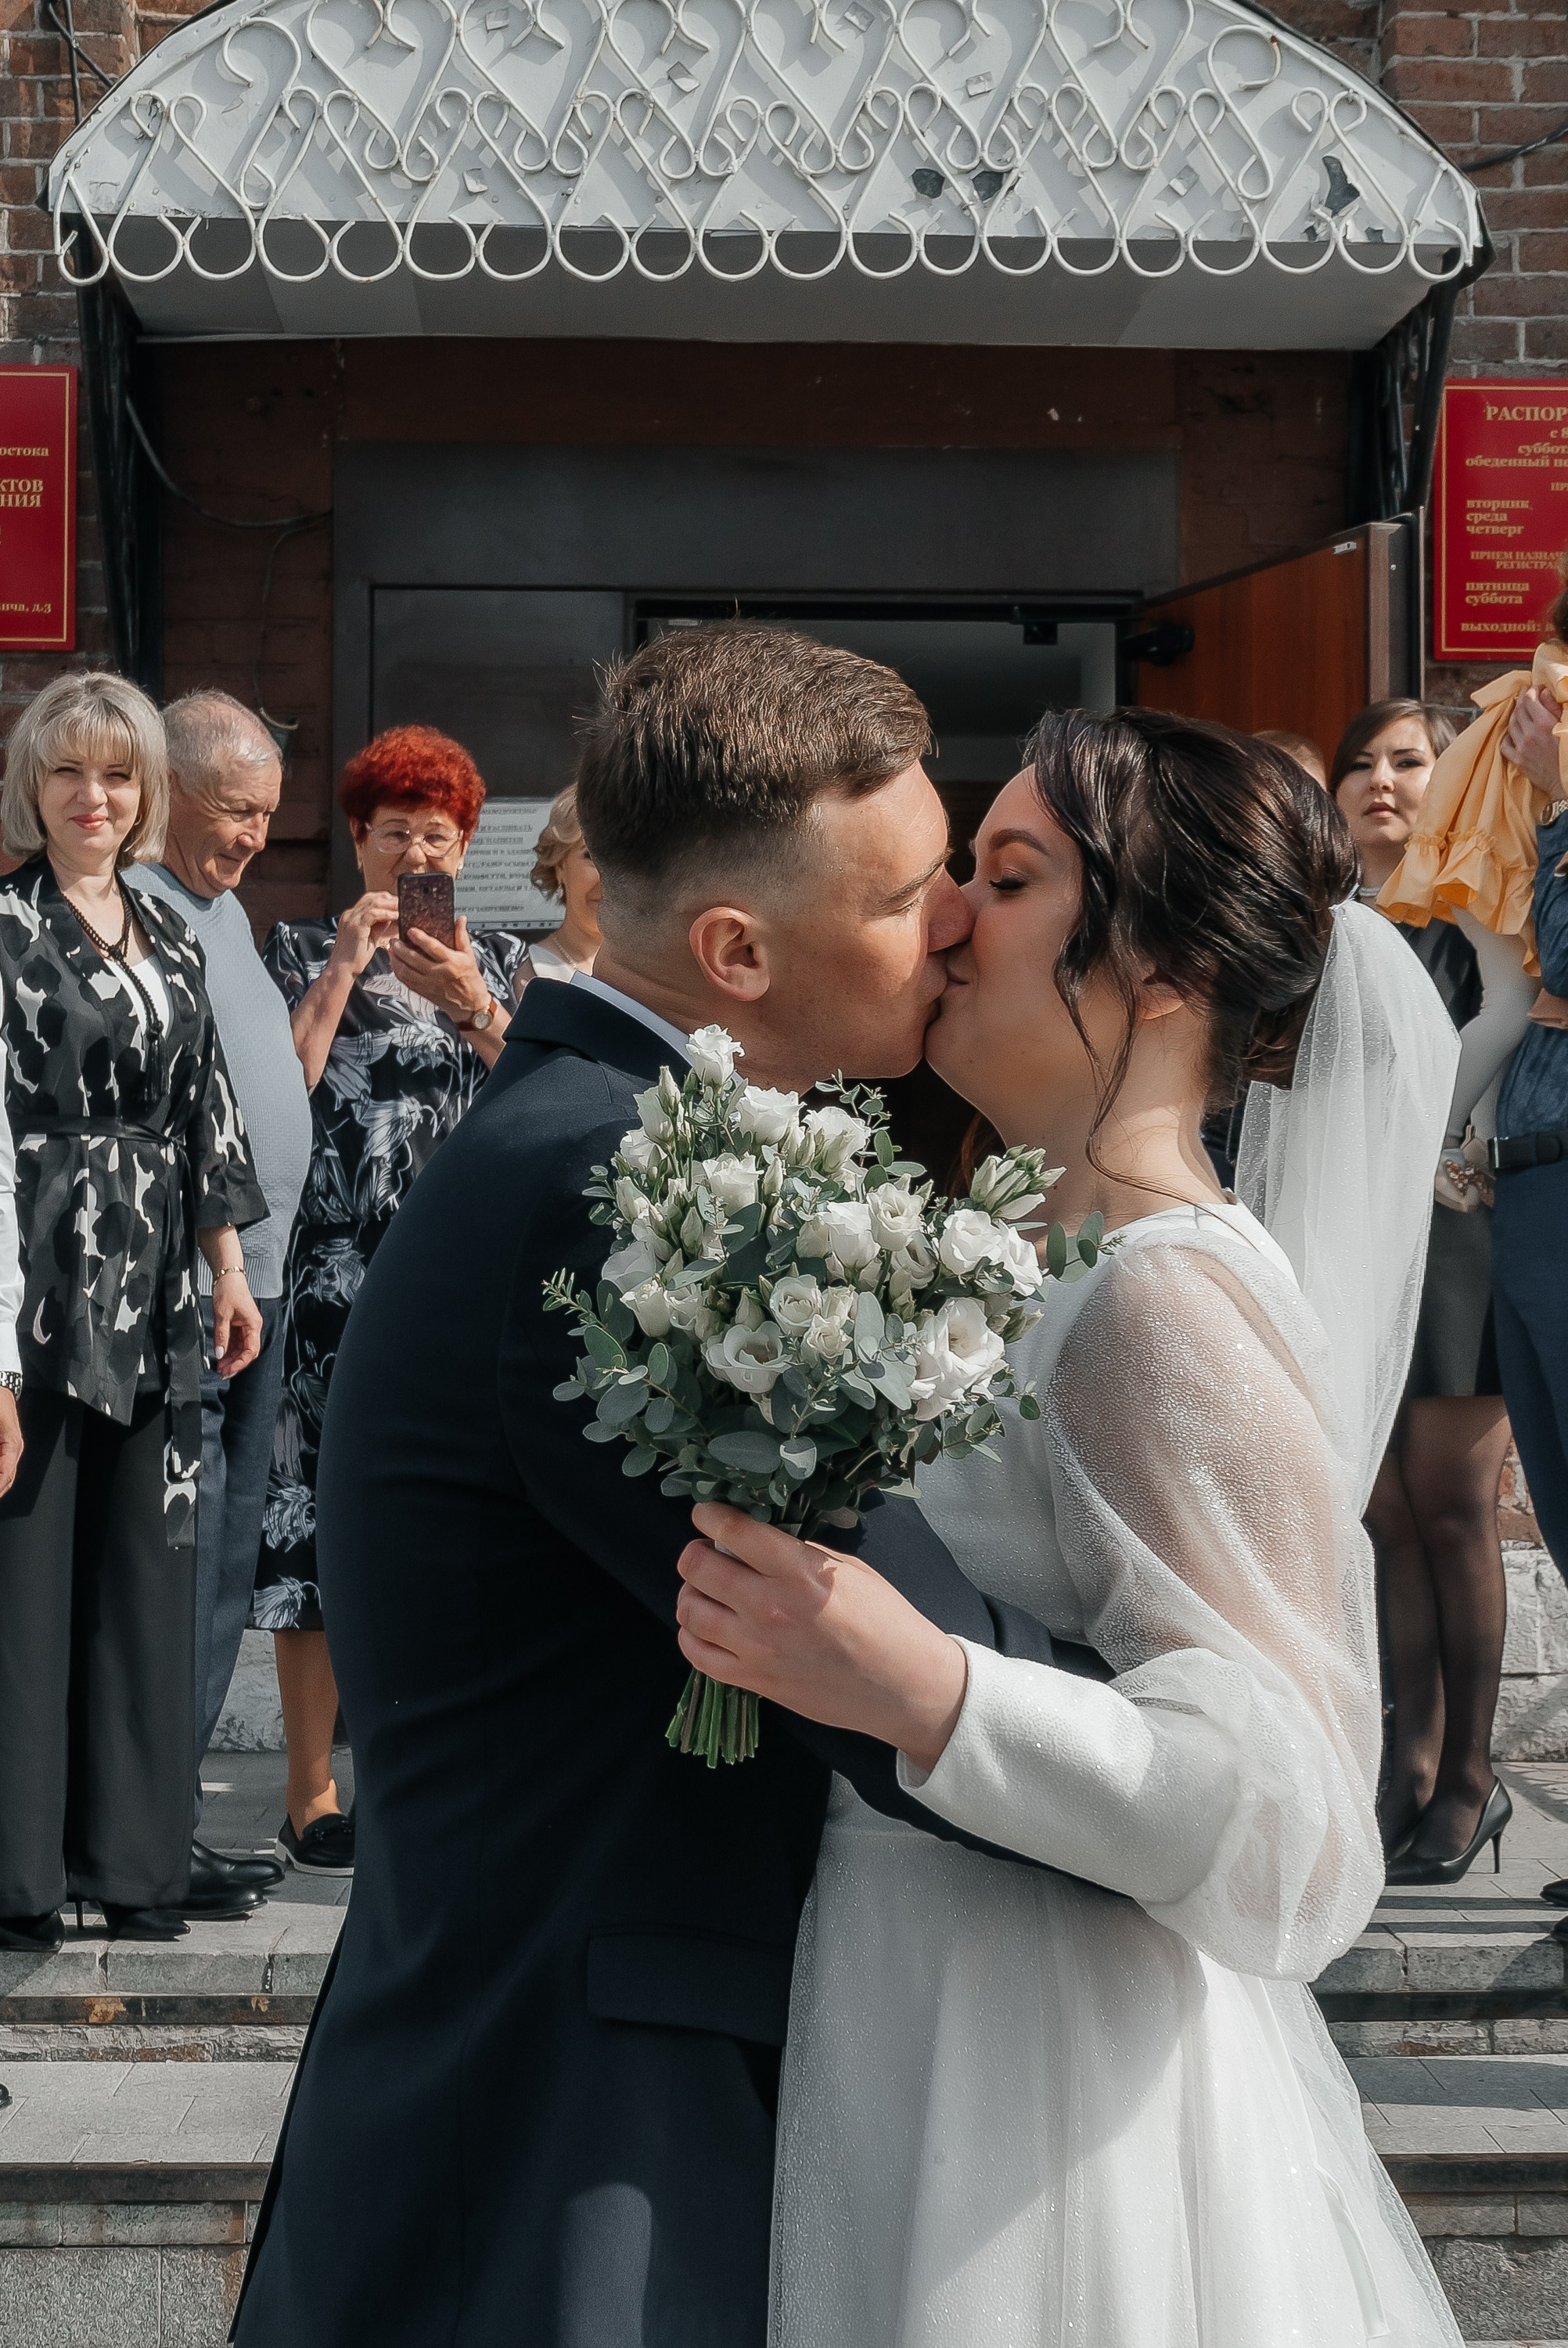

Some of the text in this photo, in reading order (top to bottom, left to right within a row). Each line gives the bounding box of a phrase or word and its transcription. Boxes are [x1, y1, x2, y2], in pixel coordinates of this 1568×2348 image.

[1467, 499, 1529, 511] вторник
[1466, 513, 1508, 524] среда
[1466, 525, 1524, 538] четверг
[1466, 582, 1530, 592] пятница
[1465, 592, 1523, 607] суббота
